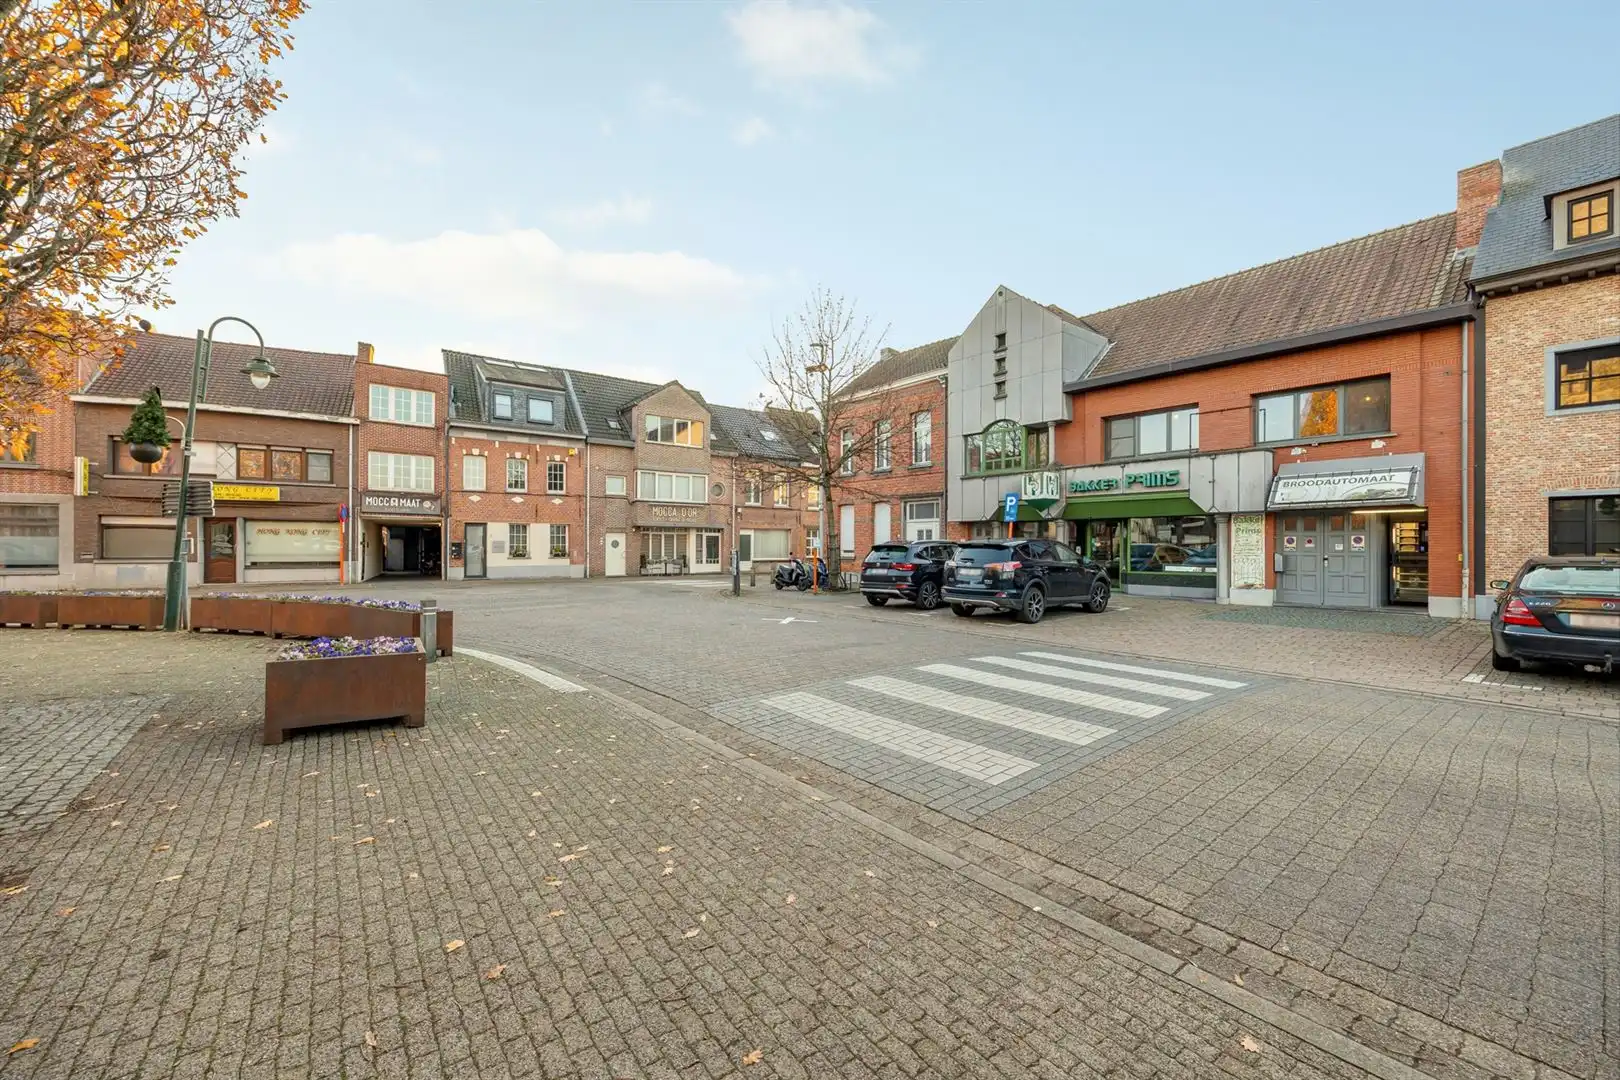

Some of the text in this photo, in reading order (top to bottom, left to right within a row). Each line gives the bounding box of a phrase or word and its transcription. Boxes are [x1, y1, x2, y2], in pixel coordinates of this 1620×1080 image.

[1067, 478, 1119, 493] BAKKER
[1125, 470, 1180, 488] PRIMS
[1282, 474, 1396, 488] BROODAUTOMAAT
[1006, 496, 1017, 511] P
[652, 506, 678, 517] MOCCA
